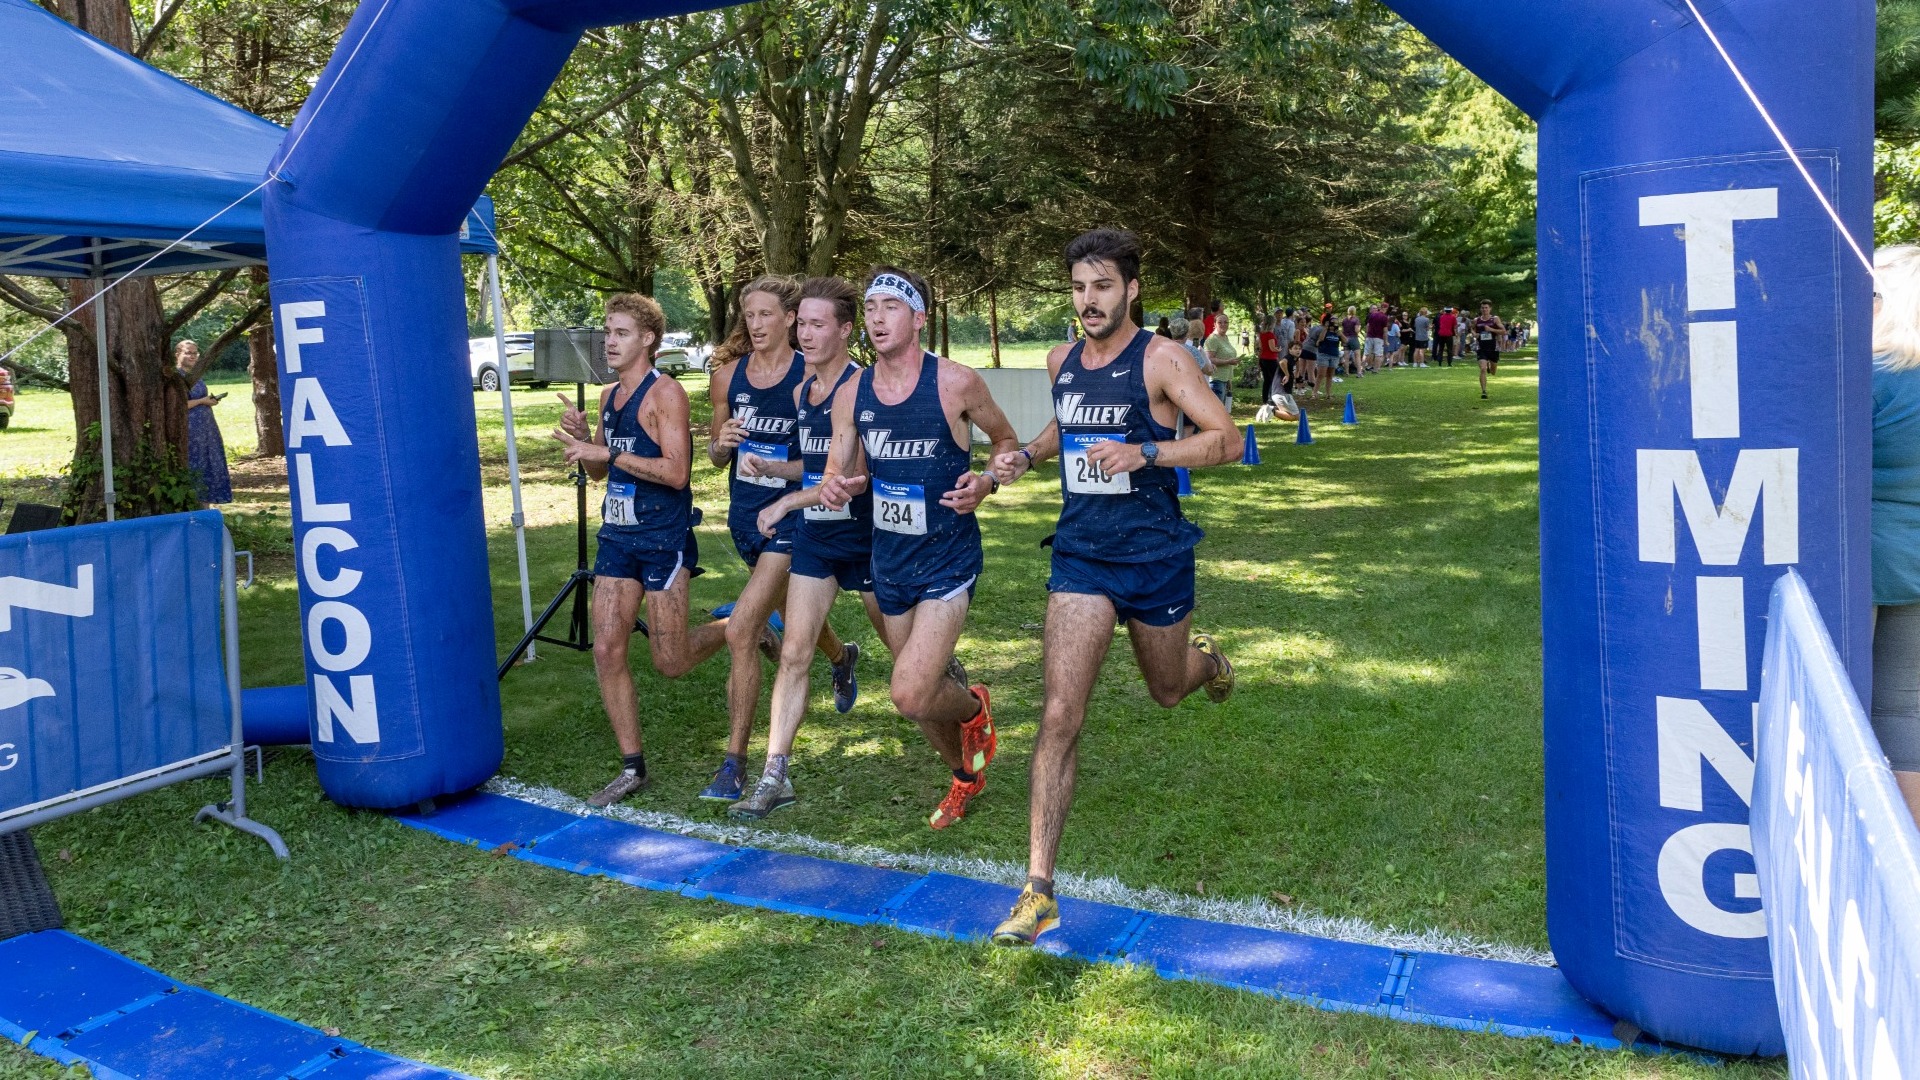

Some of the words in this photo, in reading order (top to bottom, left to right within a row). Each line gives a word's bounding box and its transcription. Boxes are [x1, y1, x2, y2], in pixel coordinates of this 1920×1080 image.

[1058, 393, 1130, 426] VALLEY
[747, 442, 776, 451] FALCON
[799, 427, 832, 454] VALLE
[865, 430, 939, 459] VALLEY
[880, 483, 911, 492] FALCON
[279, 299, 381, 745] FALCON
[609, 498, 626, 520] 231
[881, 500, 913, 526] 234
[1636, 187, 1800, 940] TIMING
